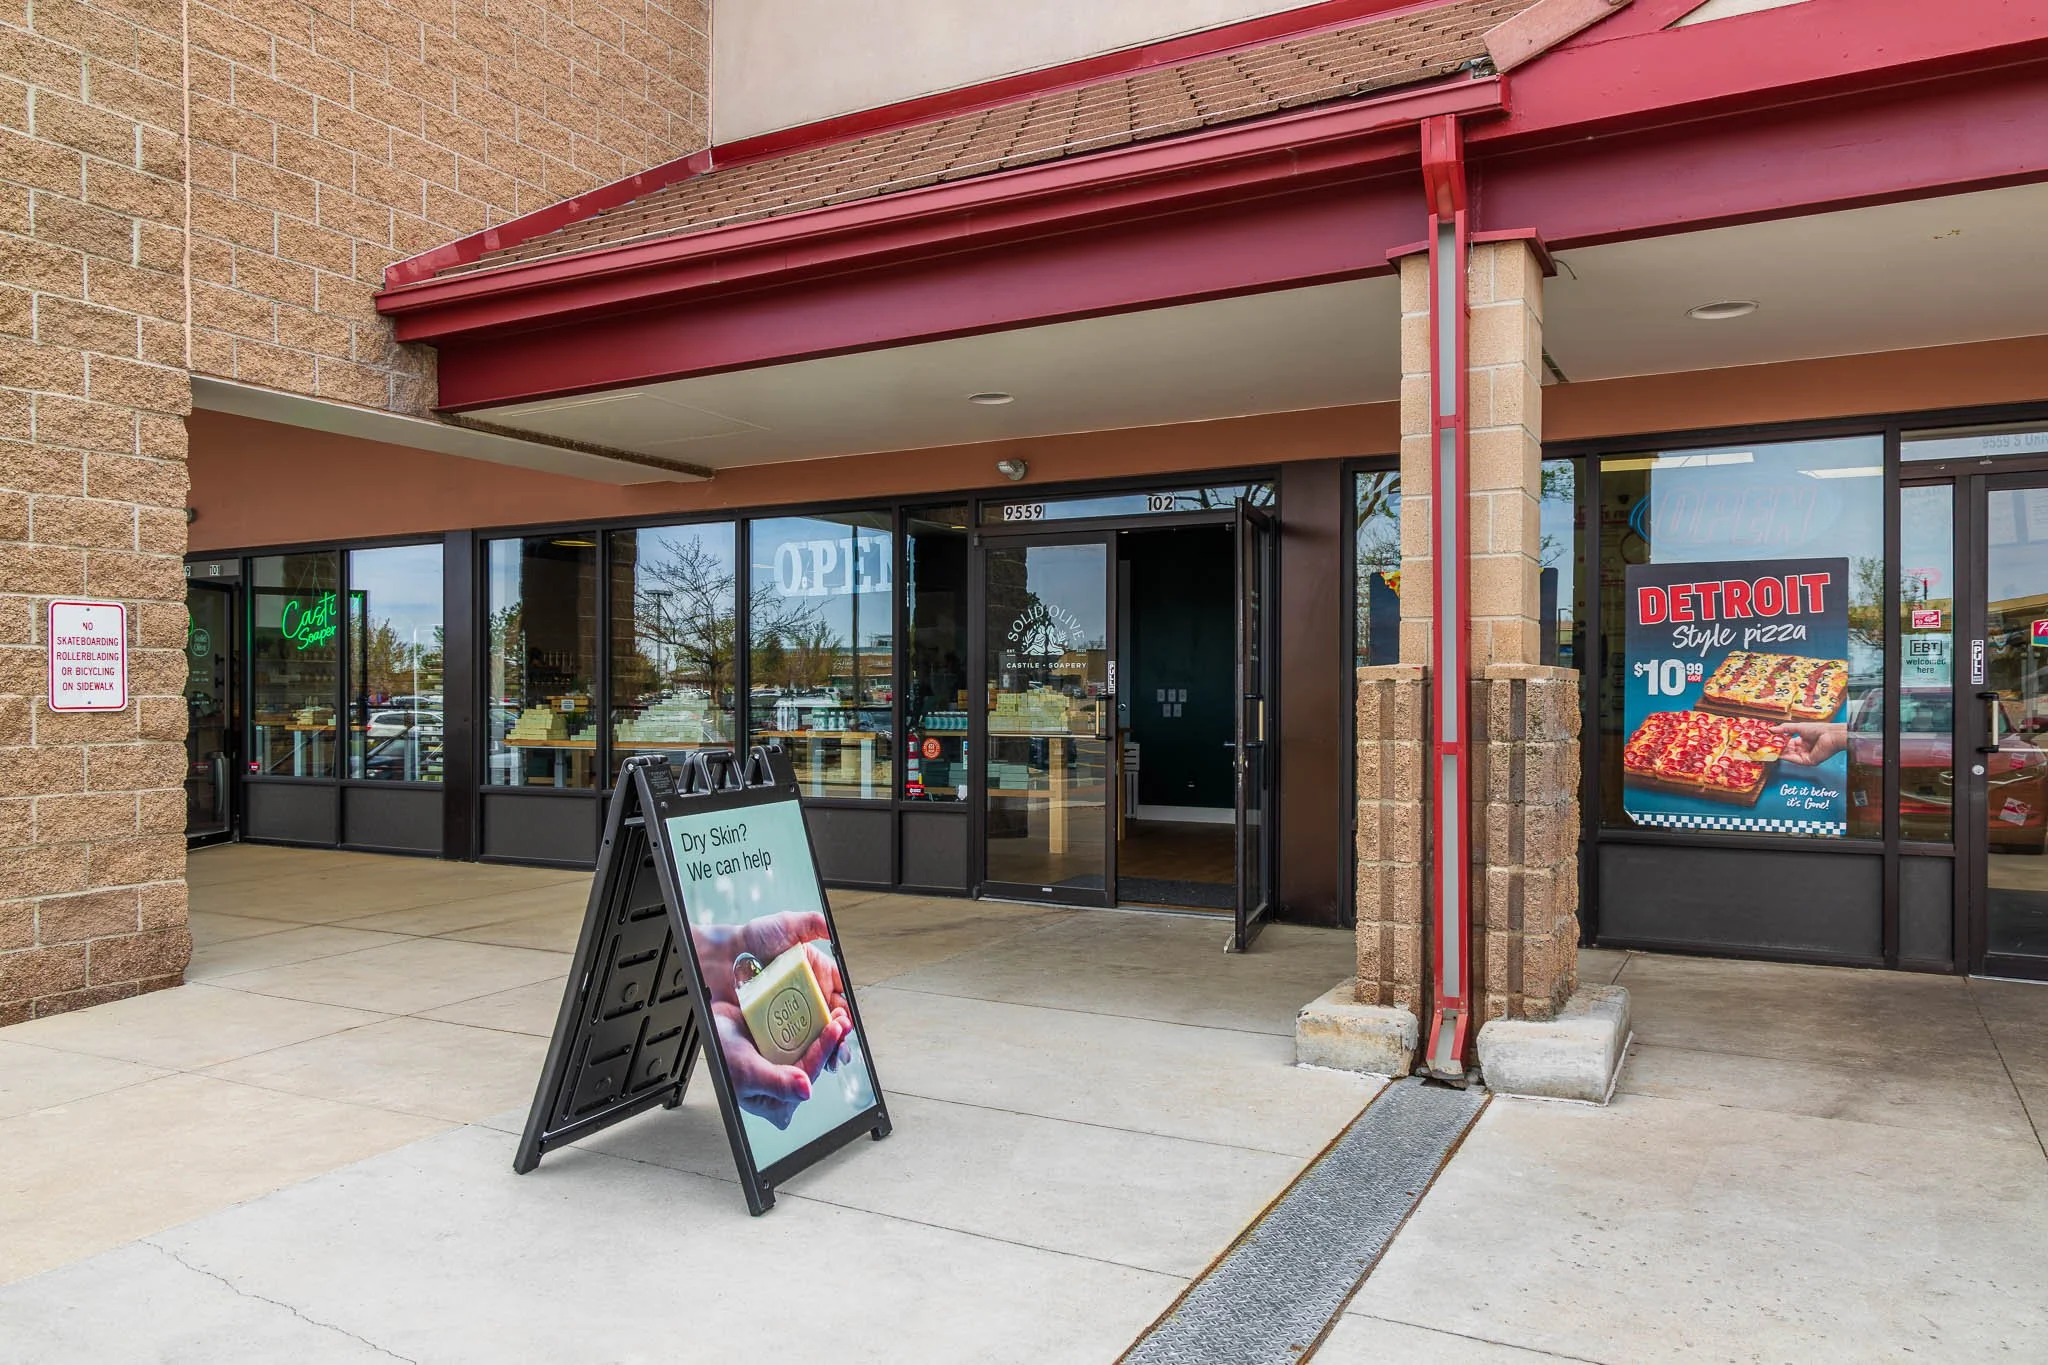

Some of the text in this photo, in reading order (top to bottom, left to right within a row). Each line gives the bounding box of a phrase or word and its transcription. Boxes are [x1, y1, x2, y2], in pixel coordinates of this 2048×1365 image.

[1148, 497, 1173, 511] 102
[1005, 505, 1042, 519] 9559
[1638, 572, 1831, 625] DETROIT
[282, 592, 336, 638] Casti
[82, 622, 93, 631] NO
[1008, 605, 1085, 642] SOLID OLIVE
[57, 636, 119, 646] SKATEBOARDING
[297, 626, 336, 650] Soaper
[1672, 623, 1807, 657] Style pizza
[1913, 642, 1939, 653] EBT
[57, 652, 119, 661] ROLLERBLADING
[1973, 645, 1982, 675] PULL
[61, 667, 115, 676] OR BICYCLING
[1917, 666, 1935, 674] here
[62, 682, 114, 691] ON SIDEWALK
[1780, 784, 1840, 798] Get it before
[1786, 796, 1830, 809] it's Gone!
[681, 823, 747, 855] Dry Skin?
[686, 848, 772, 881] We can help
[774, 994, 800, 1026] Solid
[781, 1015, 808, 1043] Olive
